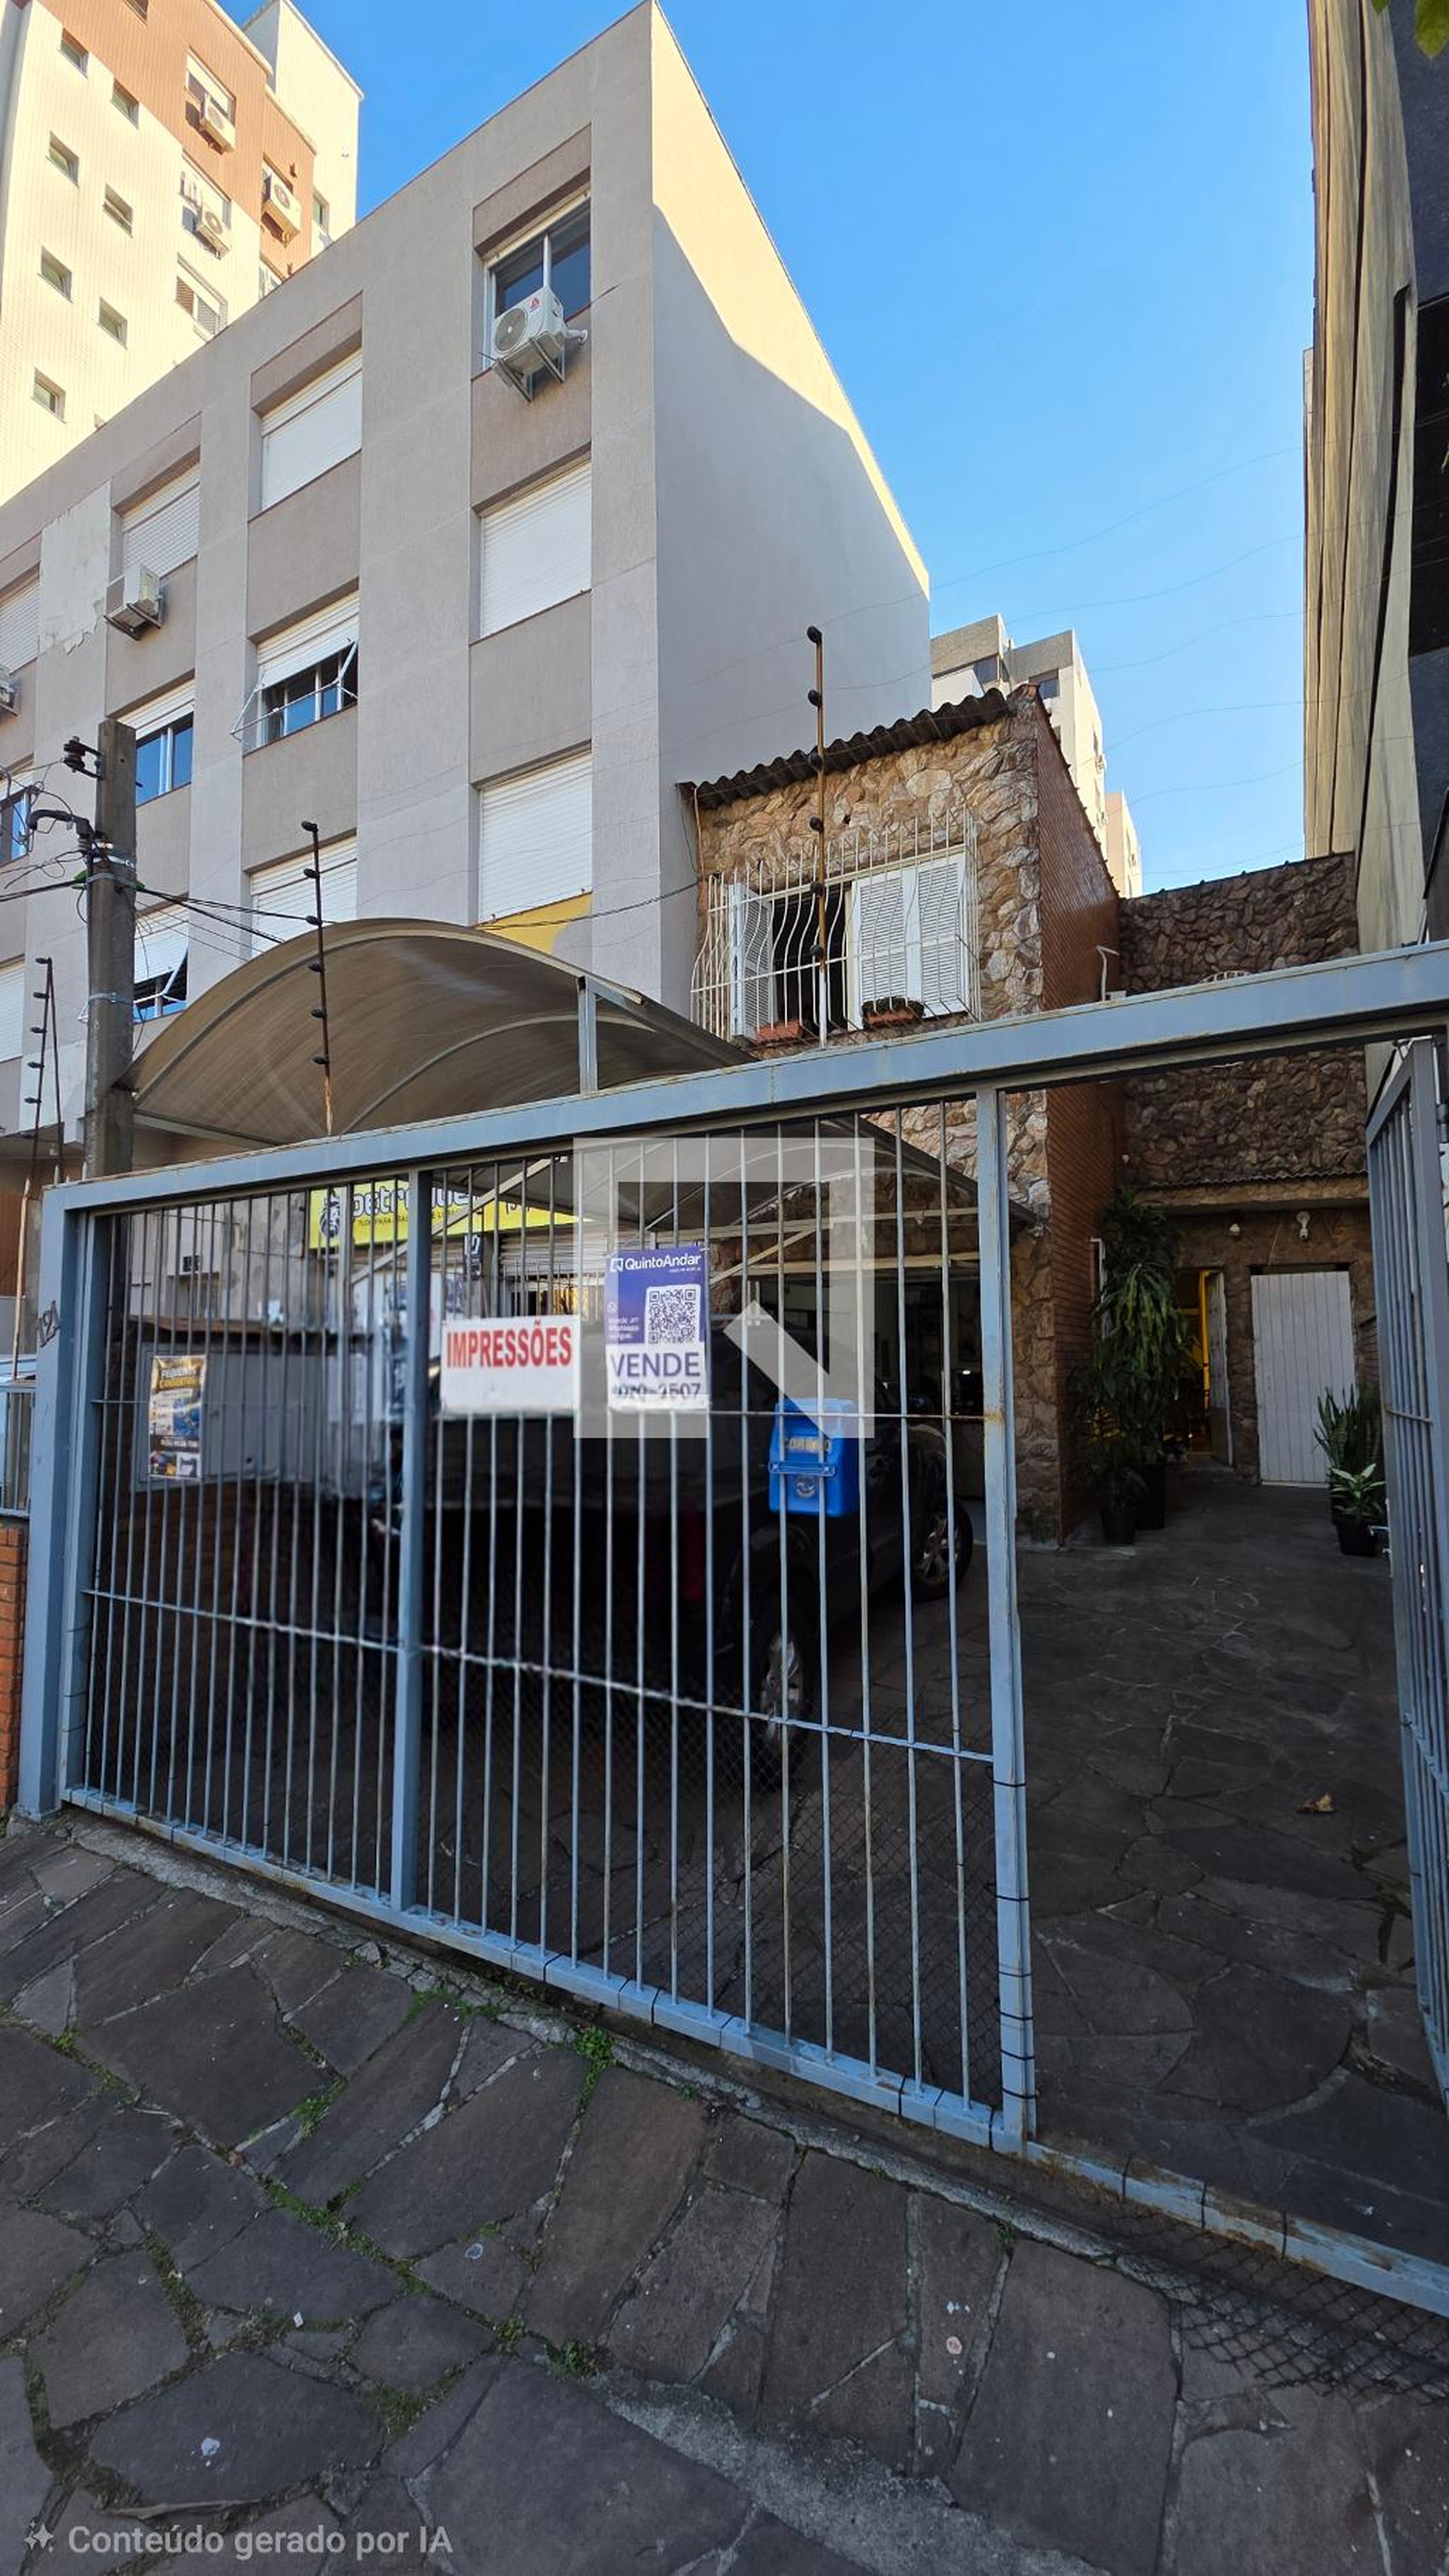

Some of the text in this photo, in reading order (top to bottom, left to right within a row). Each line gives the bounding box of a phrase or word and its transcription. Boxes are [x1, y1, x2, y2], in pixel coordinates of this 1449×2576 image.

[625, 1253, 701, 1270] QuintoAndar
[447, 1318, 571, 1368] IMPRESSÕES
[611, 1352, 701, 1377] VENDE
